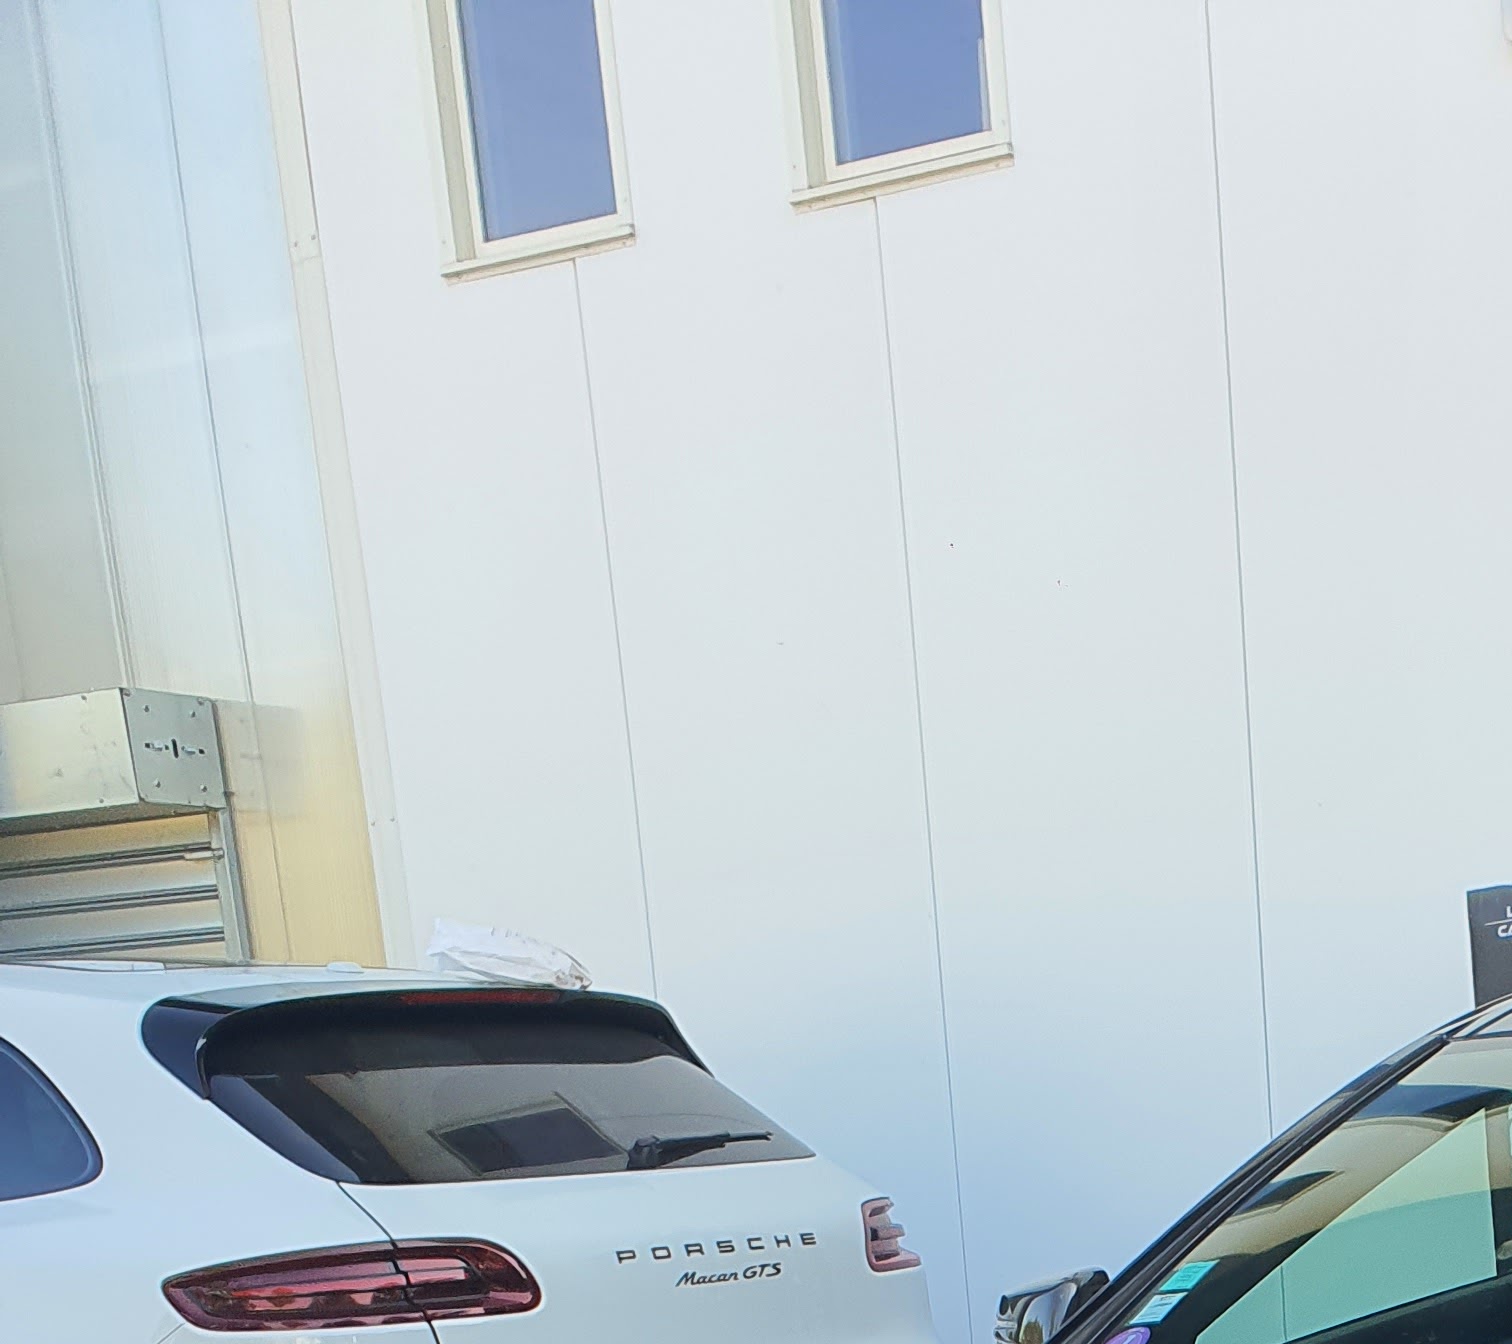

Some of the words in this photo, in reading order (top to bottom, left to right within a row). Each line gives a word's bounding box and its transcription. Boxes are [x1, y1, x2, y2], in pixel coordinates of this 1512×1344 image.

[615, 1232, 818, 1265] PORSCHE
[675, 1270, 739, 1288] Macan
[742, 1262, 782, 1280] GTS
